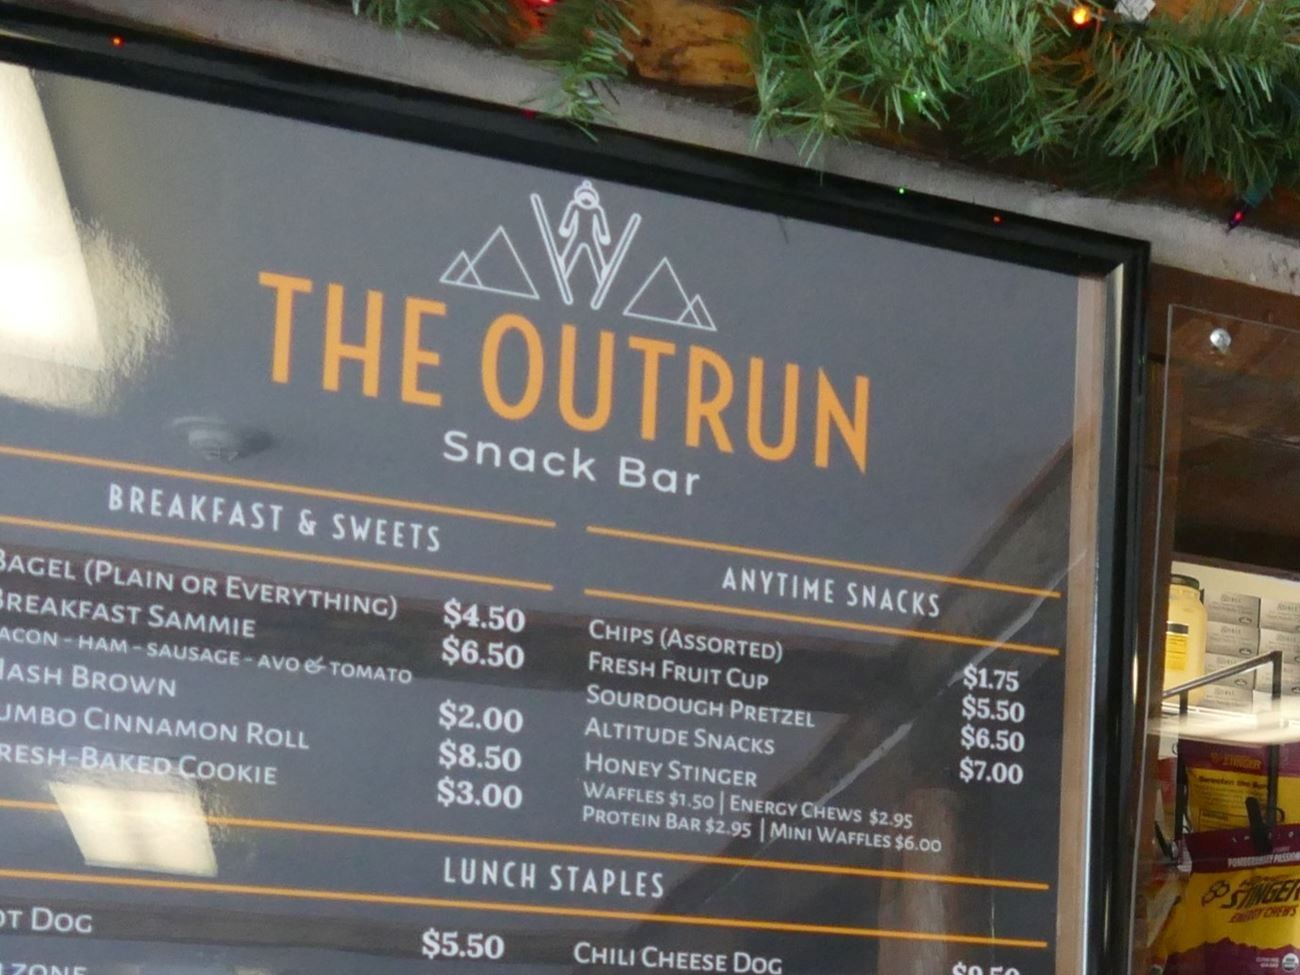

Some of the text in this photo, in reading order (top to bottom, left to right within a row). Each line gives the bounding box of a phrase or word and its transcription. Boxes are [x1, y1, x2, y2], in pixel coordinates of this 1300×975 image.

[258, 272, 870, 475] THE OUTRUN
[444, 431, 699, 495] Snack Bar
[109, 484, 439, 552] BREAKFAST & SWEETS
[722, 568, 939, 617] ANYTIME SNACKS
[444, 598, 525, 632] $4.50
[442, 635, 524, 668] $6.50
[963, 663, 1019, 691] $1.75
[962, 694, 1025, 722] $5.50
[439, 739, 521, 771] $8.50
[438, 776, 522, 808] $3.00
[706, 817, 751, 838] $2.95
[895, 834, 942, 852] $6.00
[445, 857, 663, 898] LUNCH STAPLES
